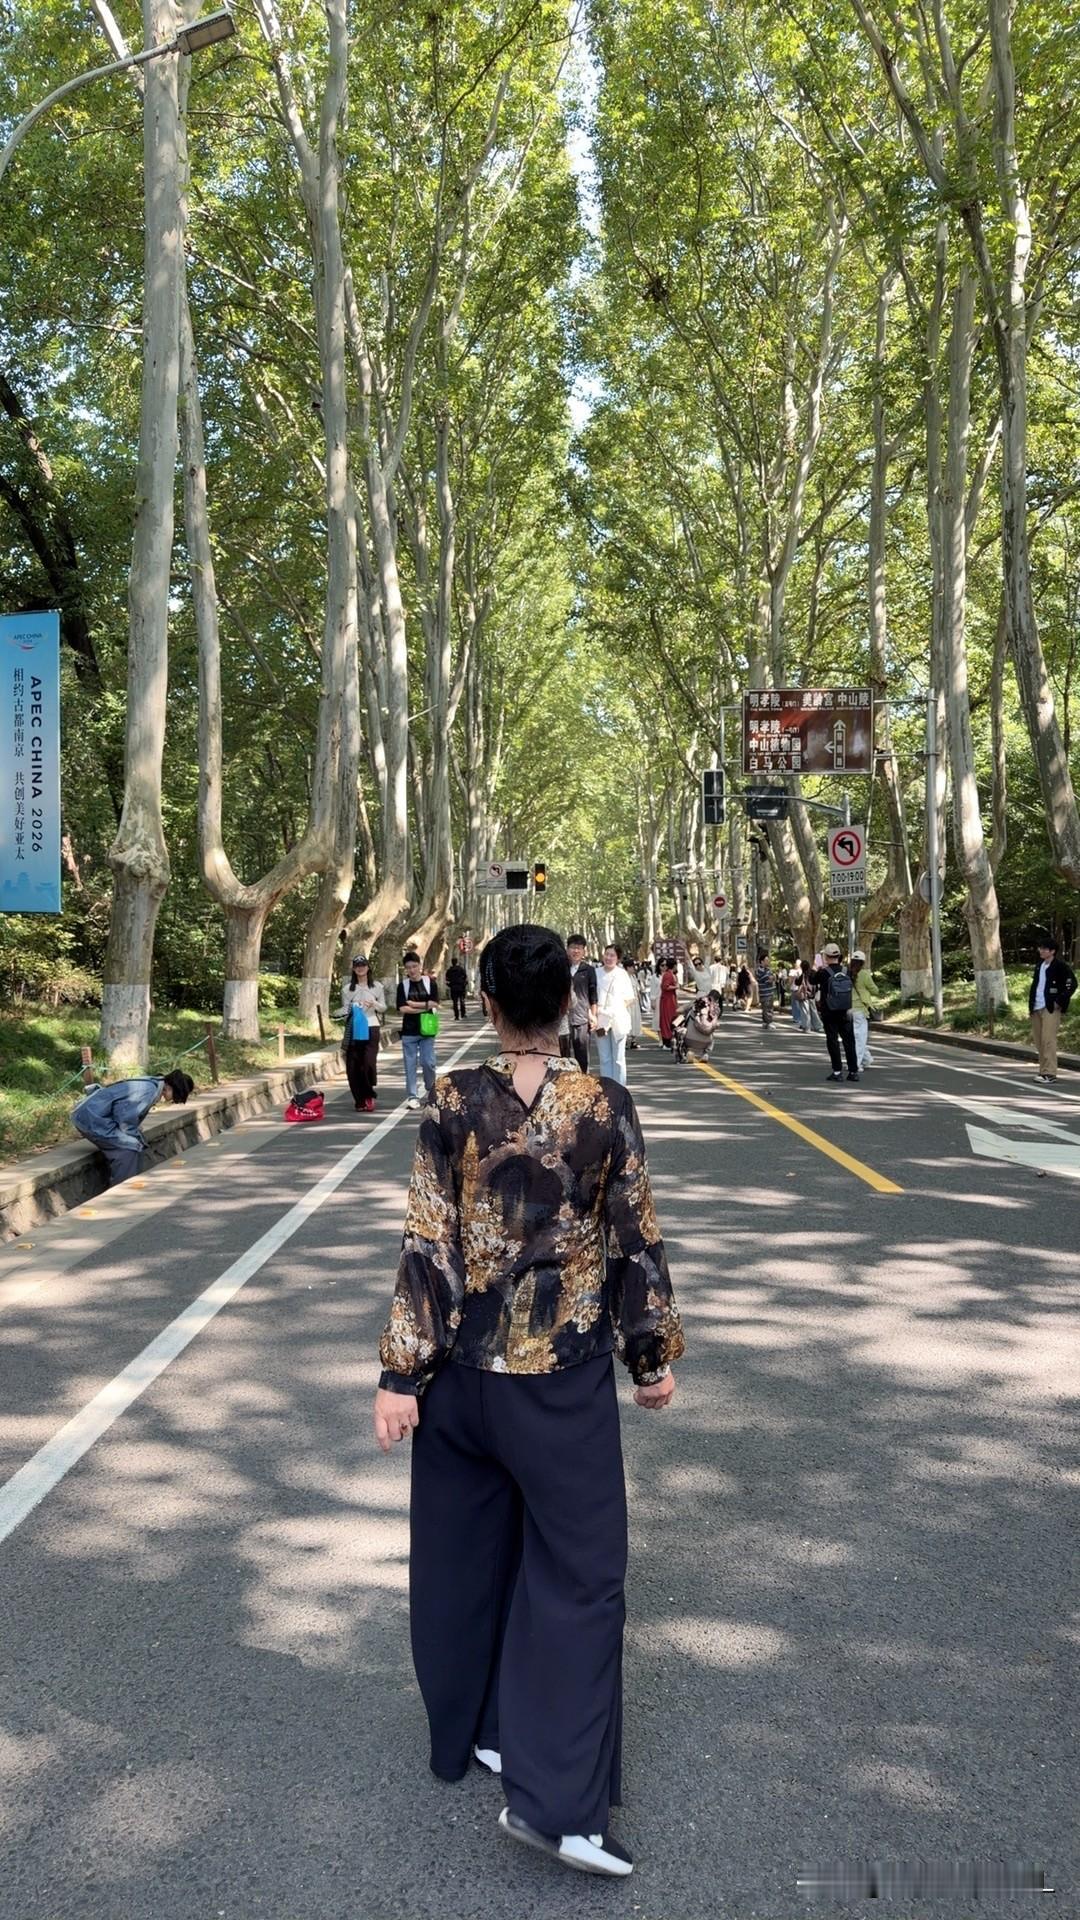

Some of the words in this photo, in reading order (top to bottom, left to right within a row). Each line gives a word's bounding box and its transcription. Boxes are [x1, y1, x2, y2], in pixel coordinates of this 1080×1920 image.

[13, 667, 25, 758] 相约古都南京
[30, 676, 43, 729] APEC
[749, 693, 781, 707] 明孝陵
[802, 692, 834, 707] 美龄宫
[837, 692, 870, 707] 中山陵
[749, 720, 781, 734] 明孝陵
[749, 737, 802, 752] 中山植物园
[31, 737, 43, 799] CHINA
[749, 756, 802, 770] 白马公园
[14, 772, 25, 861] 共创美好亚太
[31, 809, 43, 853] 2026
[831, 870, 864, 884] 7:00-19:00
